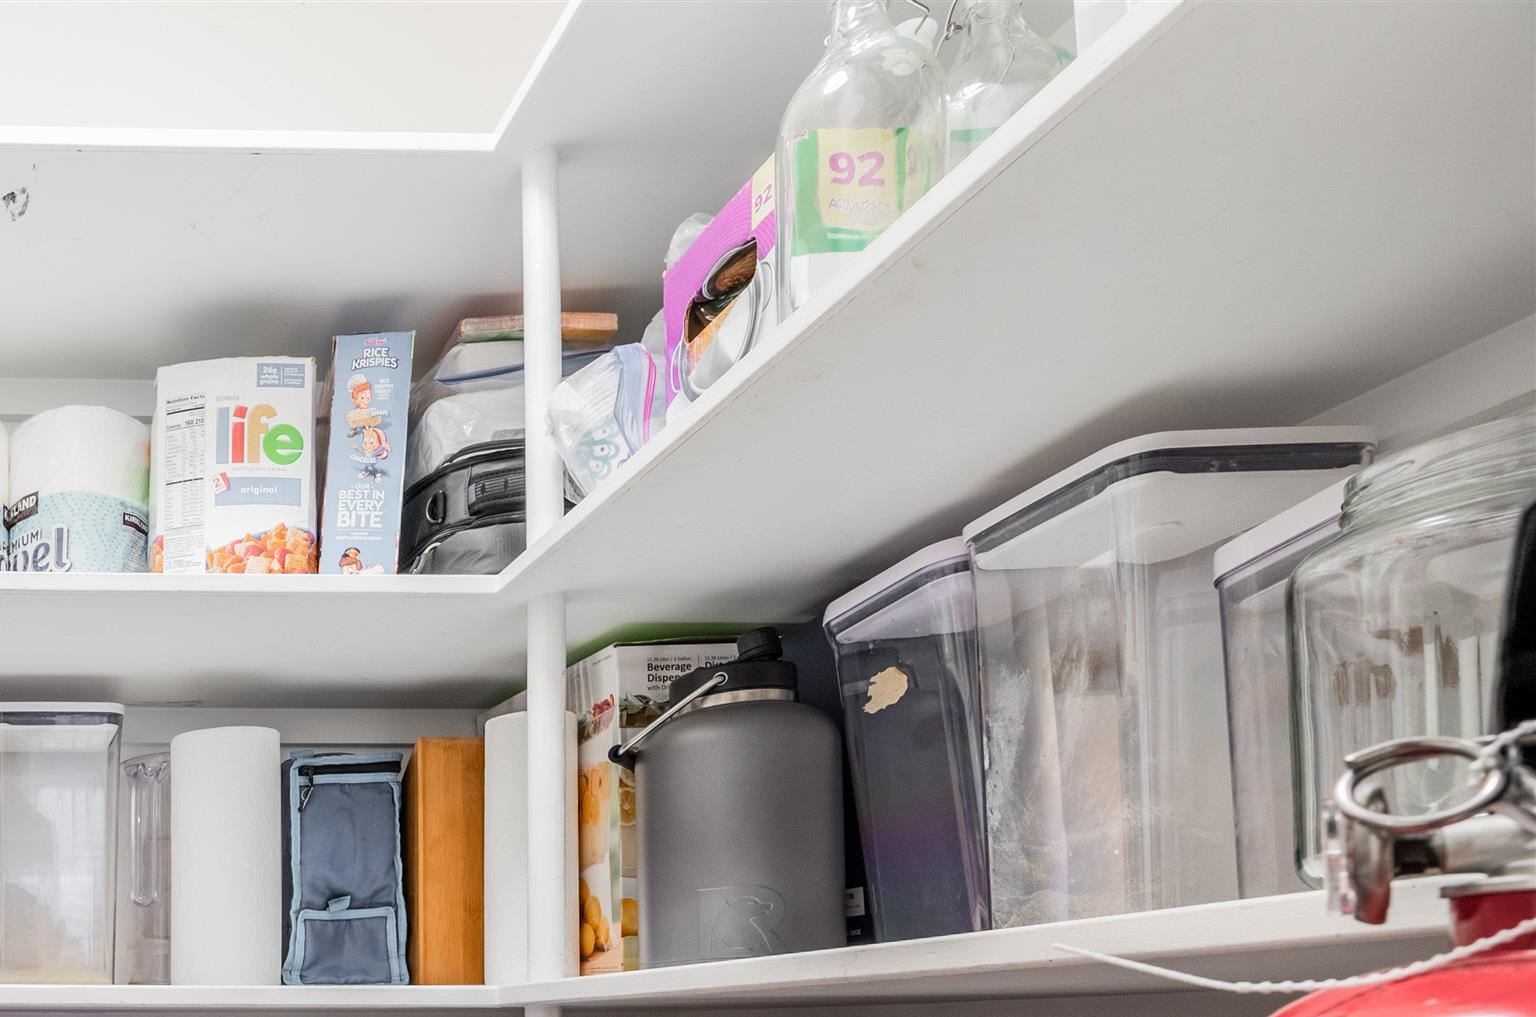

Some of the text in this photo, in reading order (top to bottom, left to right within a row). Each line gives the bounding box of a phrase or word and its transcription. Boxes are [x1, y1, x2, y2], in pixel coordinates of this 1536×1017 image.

[828, 151, 885, 187] 92
[754, 184, 773, 213] 92
[363, 347, 390, 358] RICE
[351, 358, 400, 370] KRISPIES
[216, 403, 304, 465] life
[240, 486, 278, 495] original
[338, 490, 384, 499] BEST IN
[338, 500, 384, 510] EVERY
[336, 511, 383, 528] BITE
[647, 663, 692, 671] Beverage
[647, 674, 681, 683] Dispen
